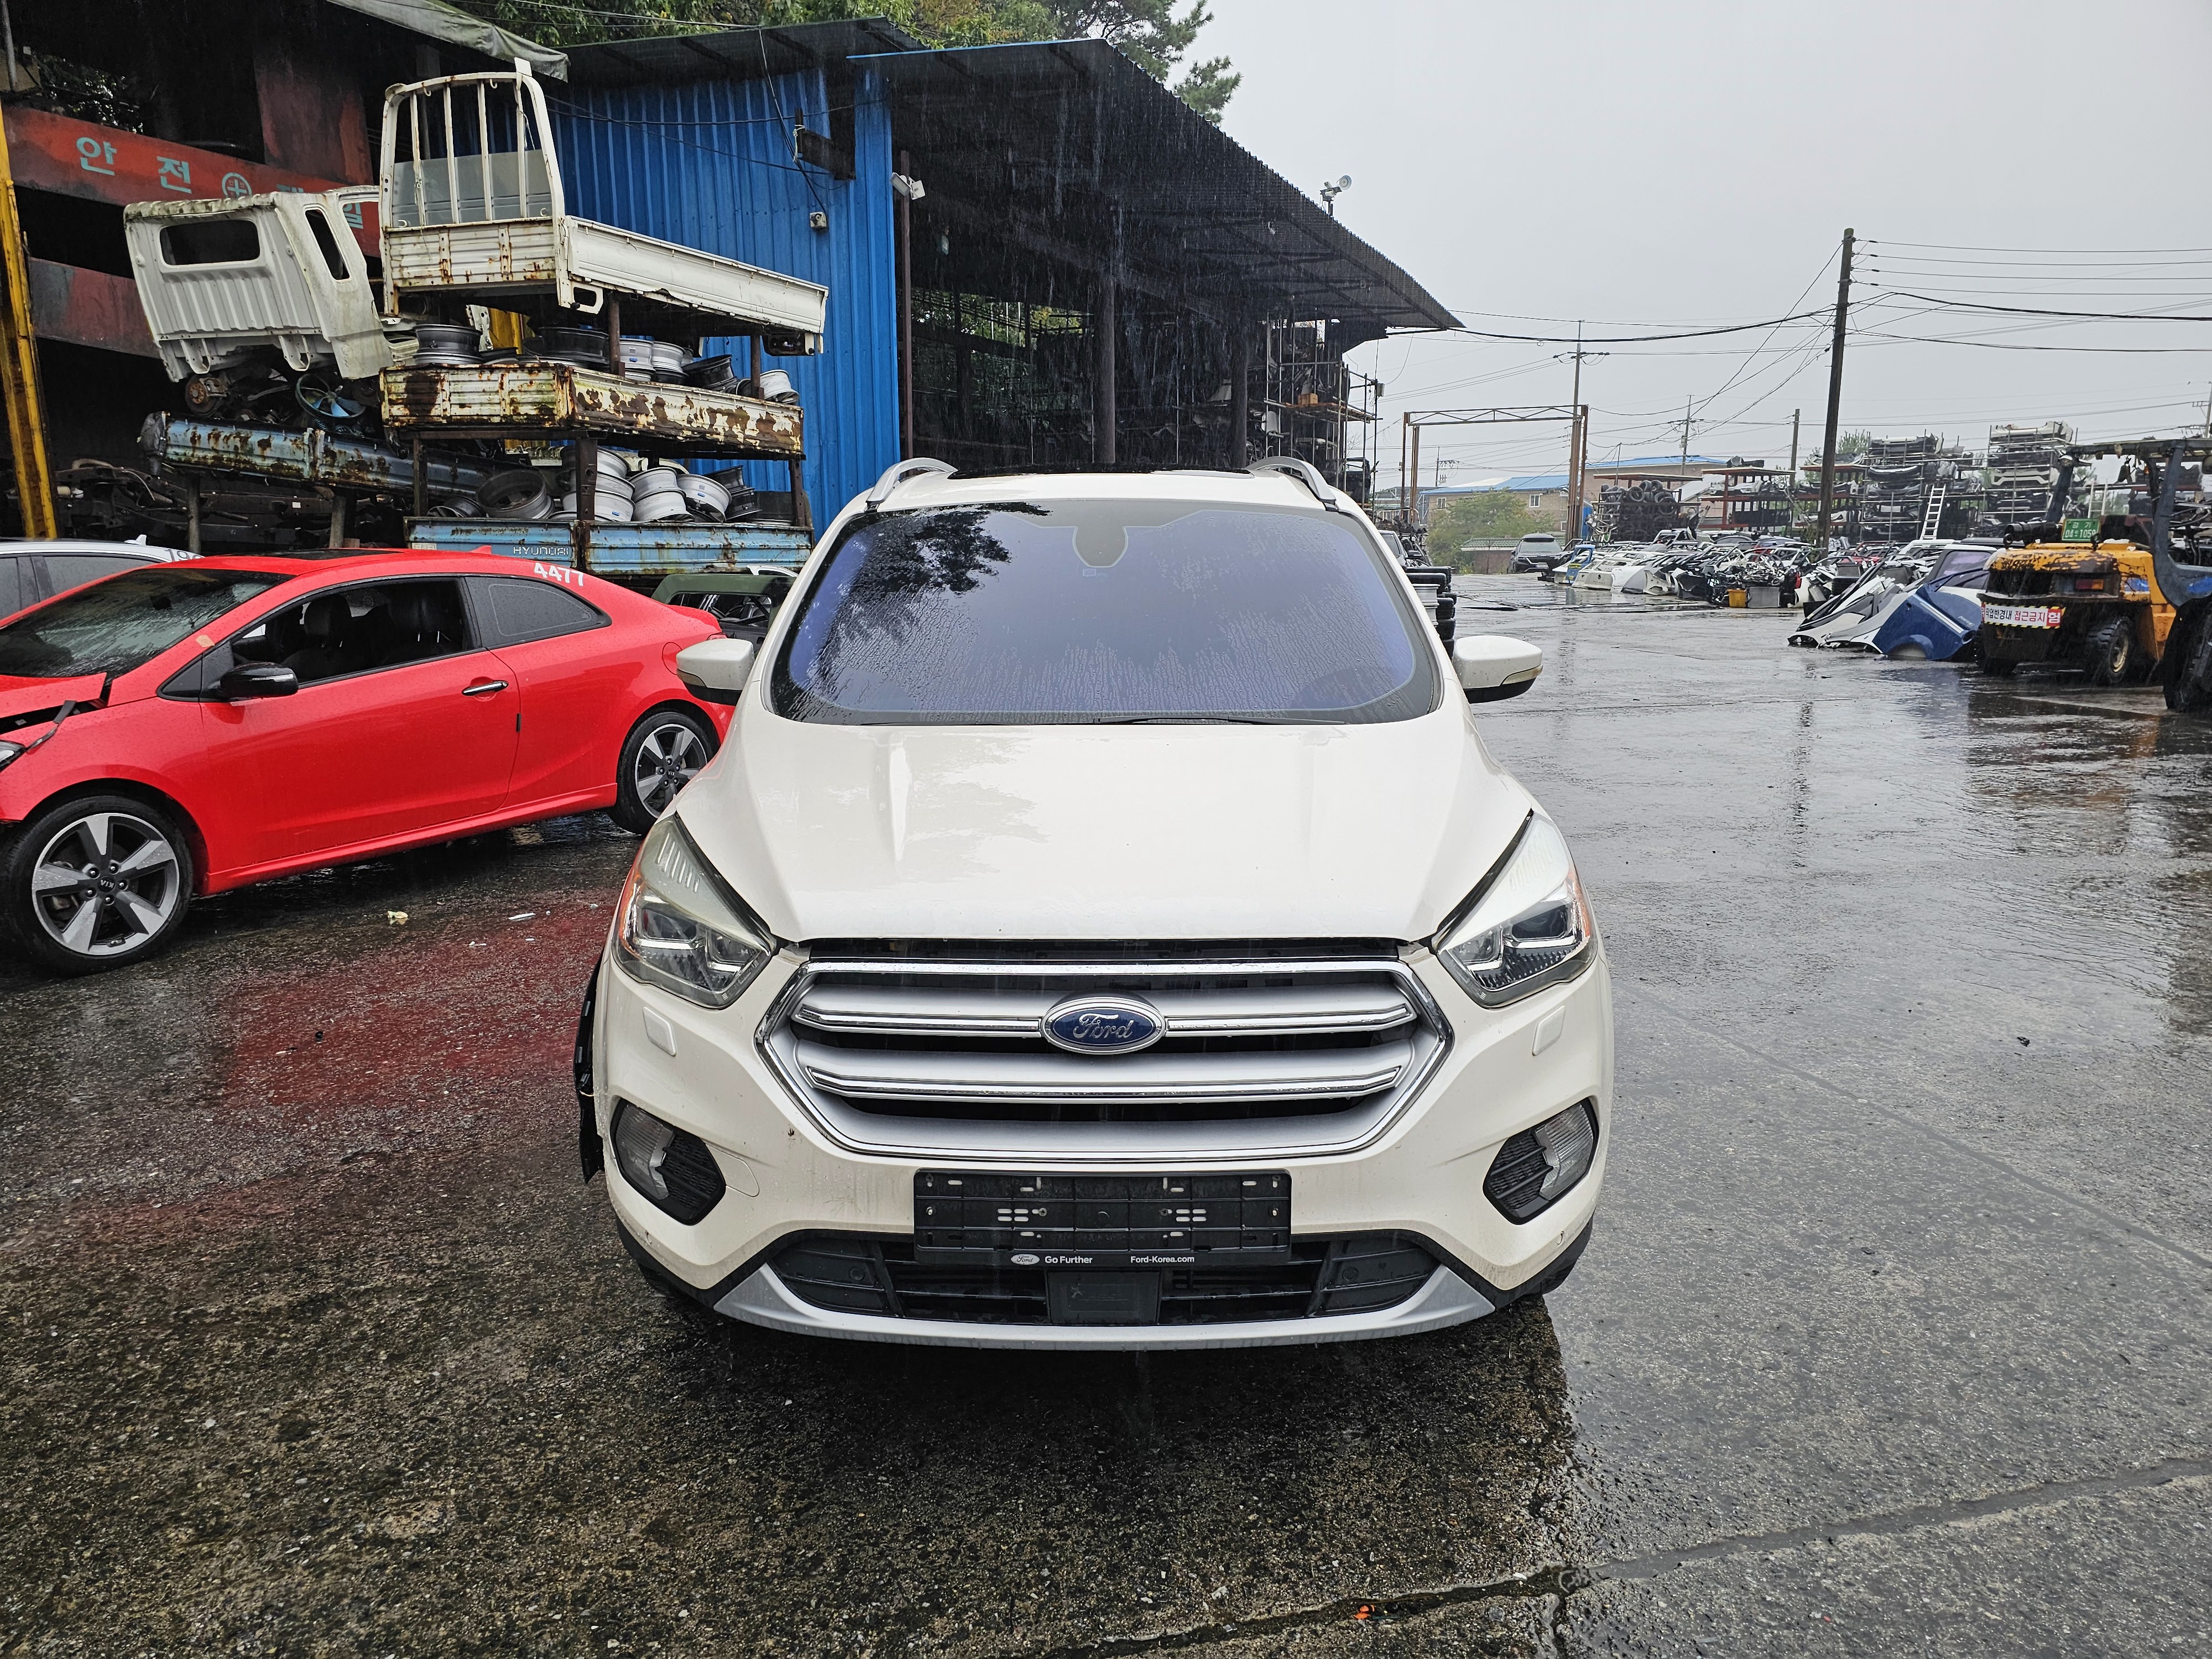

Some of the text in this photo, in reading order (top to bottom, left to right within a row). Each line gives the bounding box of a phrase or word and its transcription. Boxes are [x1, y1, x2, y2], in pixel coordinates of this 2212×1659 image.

[513, 546, 569, 555] HYUNDAI
[534, 562, 583, 586] 4477
[1986, 608, 2012, 620] 작업반경내
[2015, 611, 2046, 622] 접근금지
[2048, 612, 2060, 623] 험
[1073, 1013, 1134, 1039] Ford
